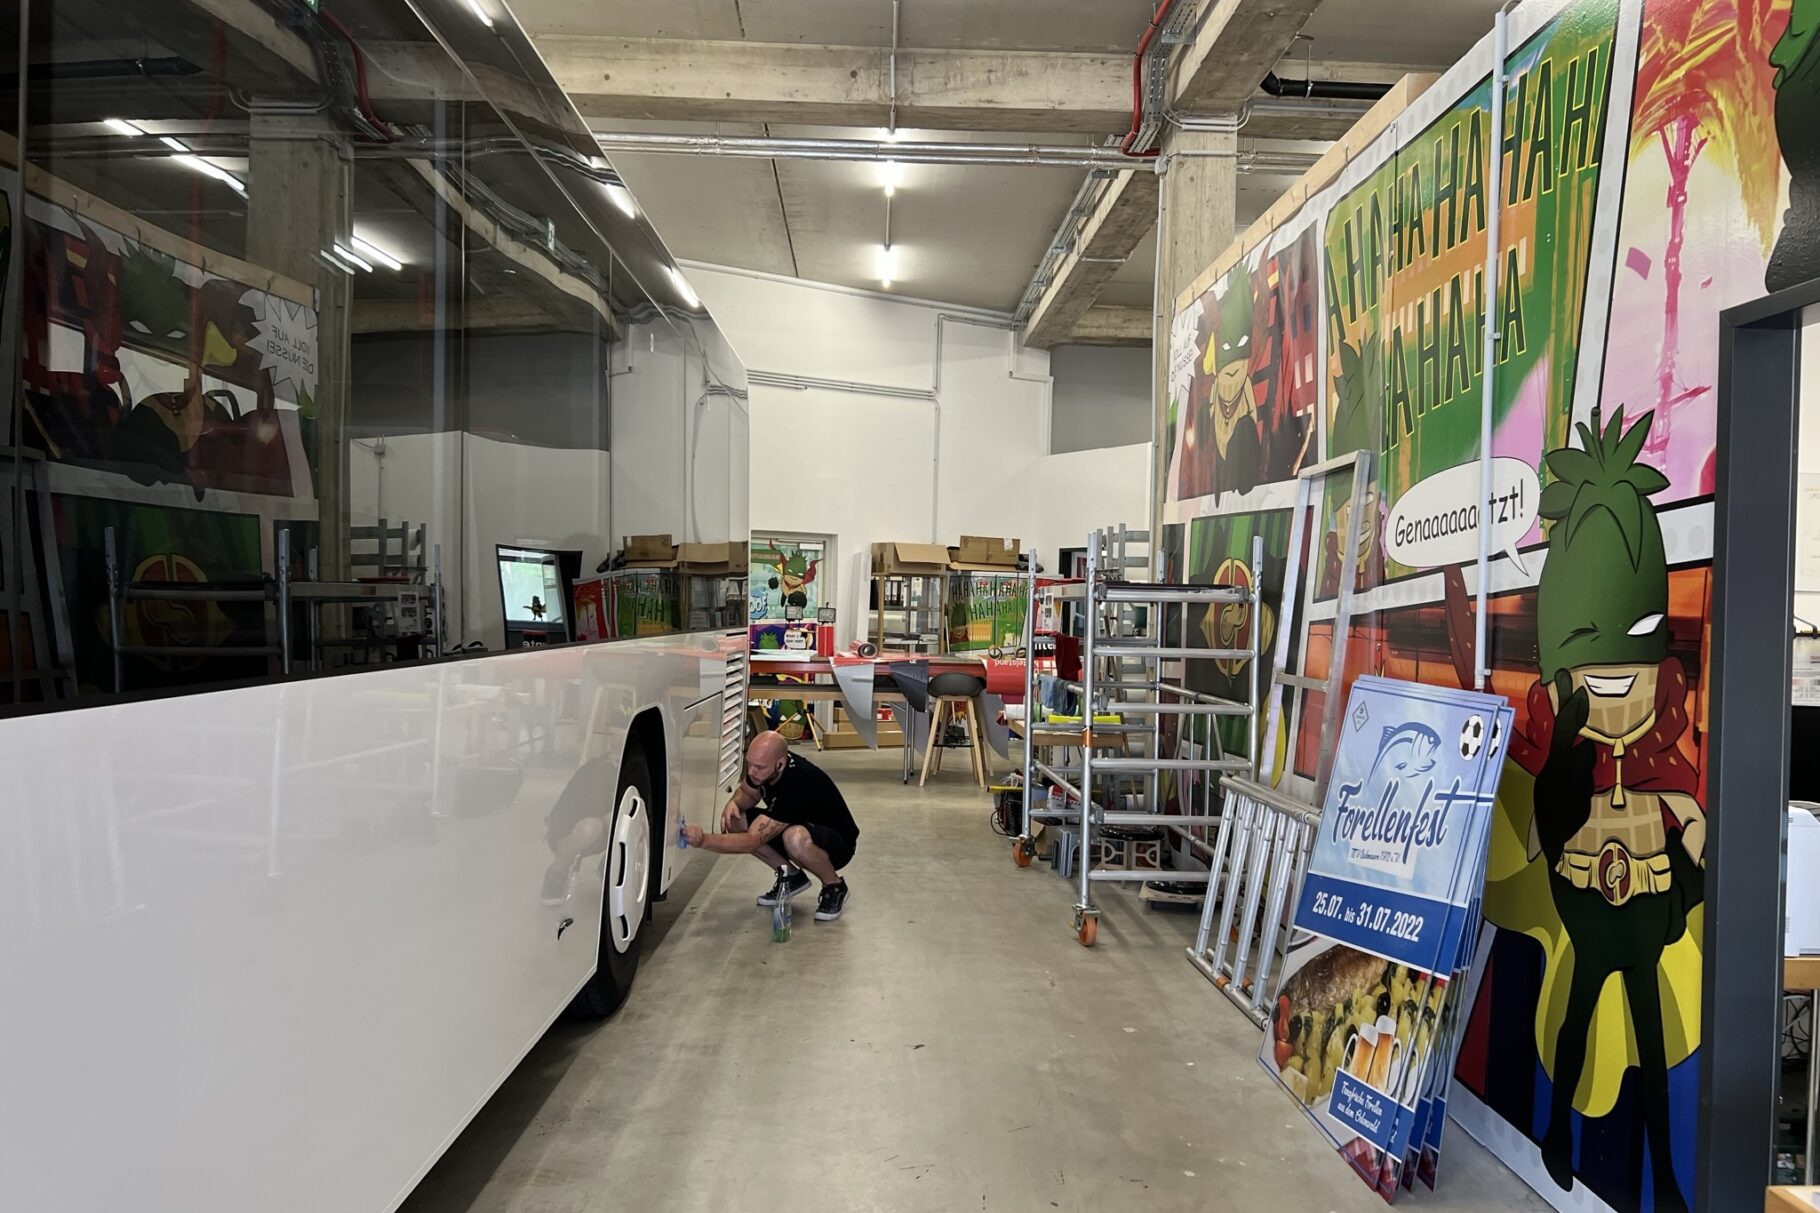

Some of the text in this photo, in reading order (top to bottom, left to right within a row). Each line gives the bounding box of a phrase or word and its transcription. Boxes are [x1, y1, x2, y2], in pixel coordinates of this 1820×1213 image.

[1332, 778, 1477, 865] Forellenfest
[1312, 891, 1424, 942] 25.07. bis 31.07.2022
